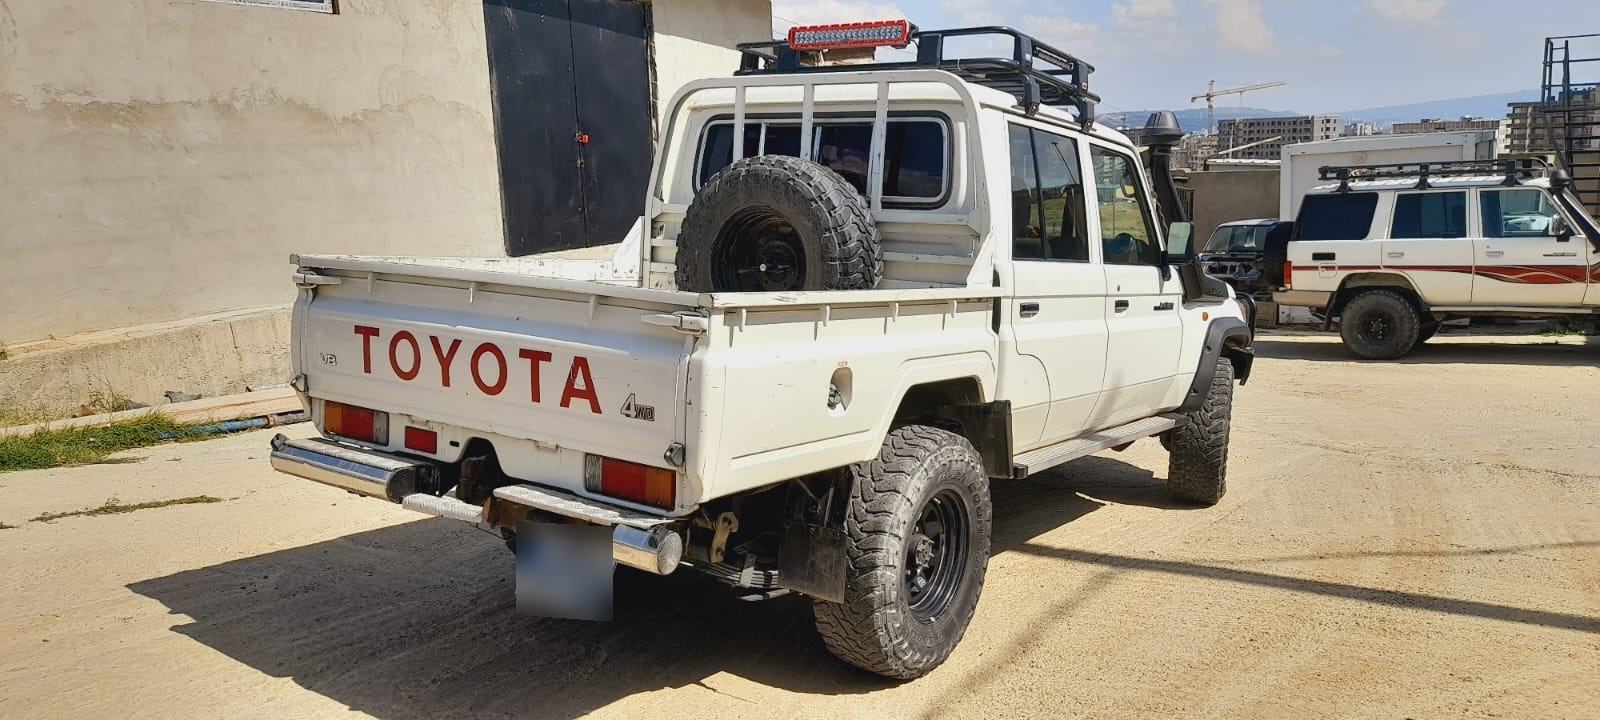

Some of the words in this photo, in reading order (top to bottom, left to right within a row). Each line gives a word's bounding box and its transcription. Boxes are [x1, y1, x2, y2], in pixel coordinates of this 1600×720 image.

[319, 352, 338, 366] V8
[354, 324, 602, 414] TOYOTA
[619, 392, 655, 422] 4WD
